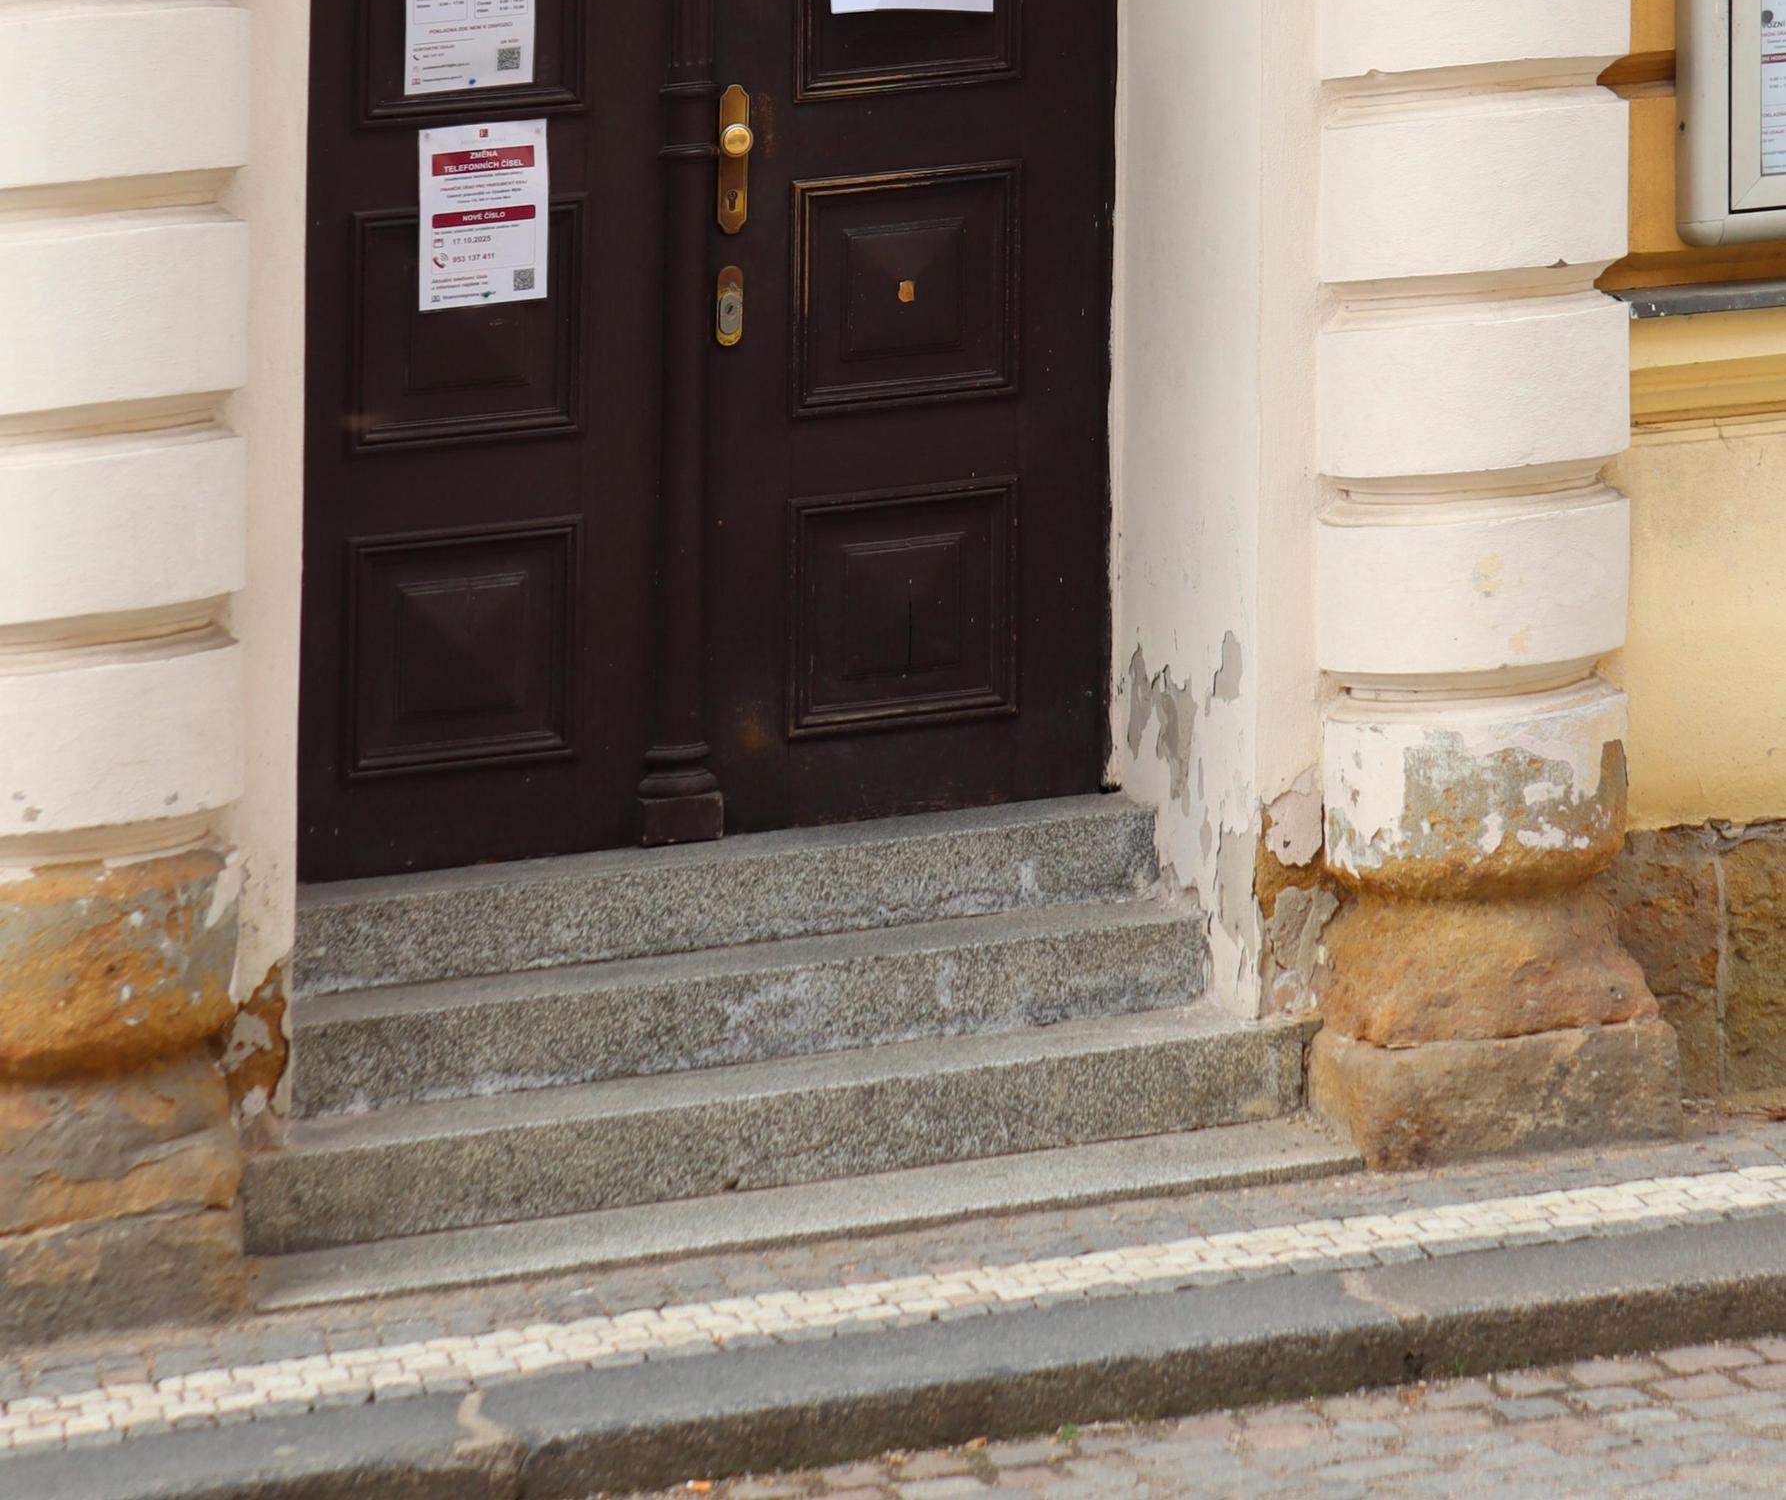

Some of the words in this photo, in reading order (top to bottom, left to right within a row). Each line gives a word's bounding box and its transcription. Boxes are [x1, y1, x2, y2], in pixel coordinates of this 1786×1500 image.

[469, 148, 498, 160] ZMĚNA
[443, 160, 500, 173] TELEFONNÍCH
[500, 158, 524, 168] ČÍSEL
[462, 212, 483, 222] NOVÉ
[483, 211, 506, 220] ČÍSLO
[452, 235, 492, 245] 17.10.2025
